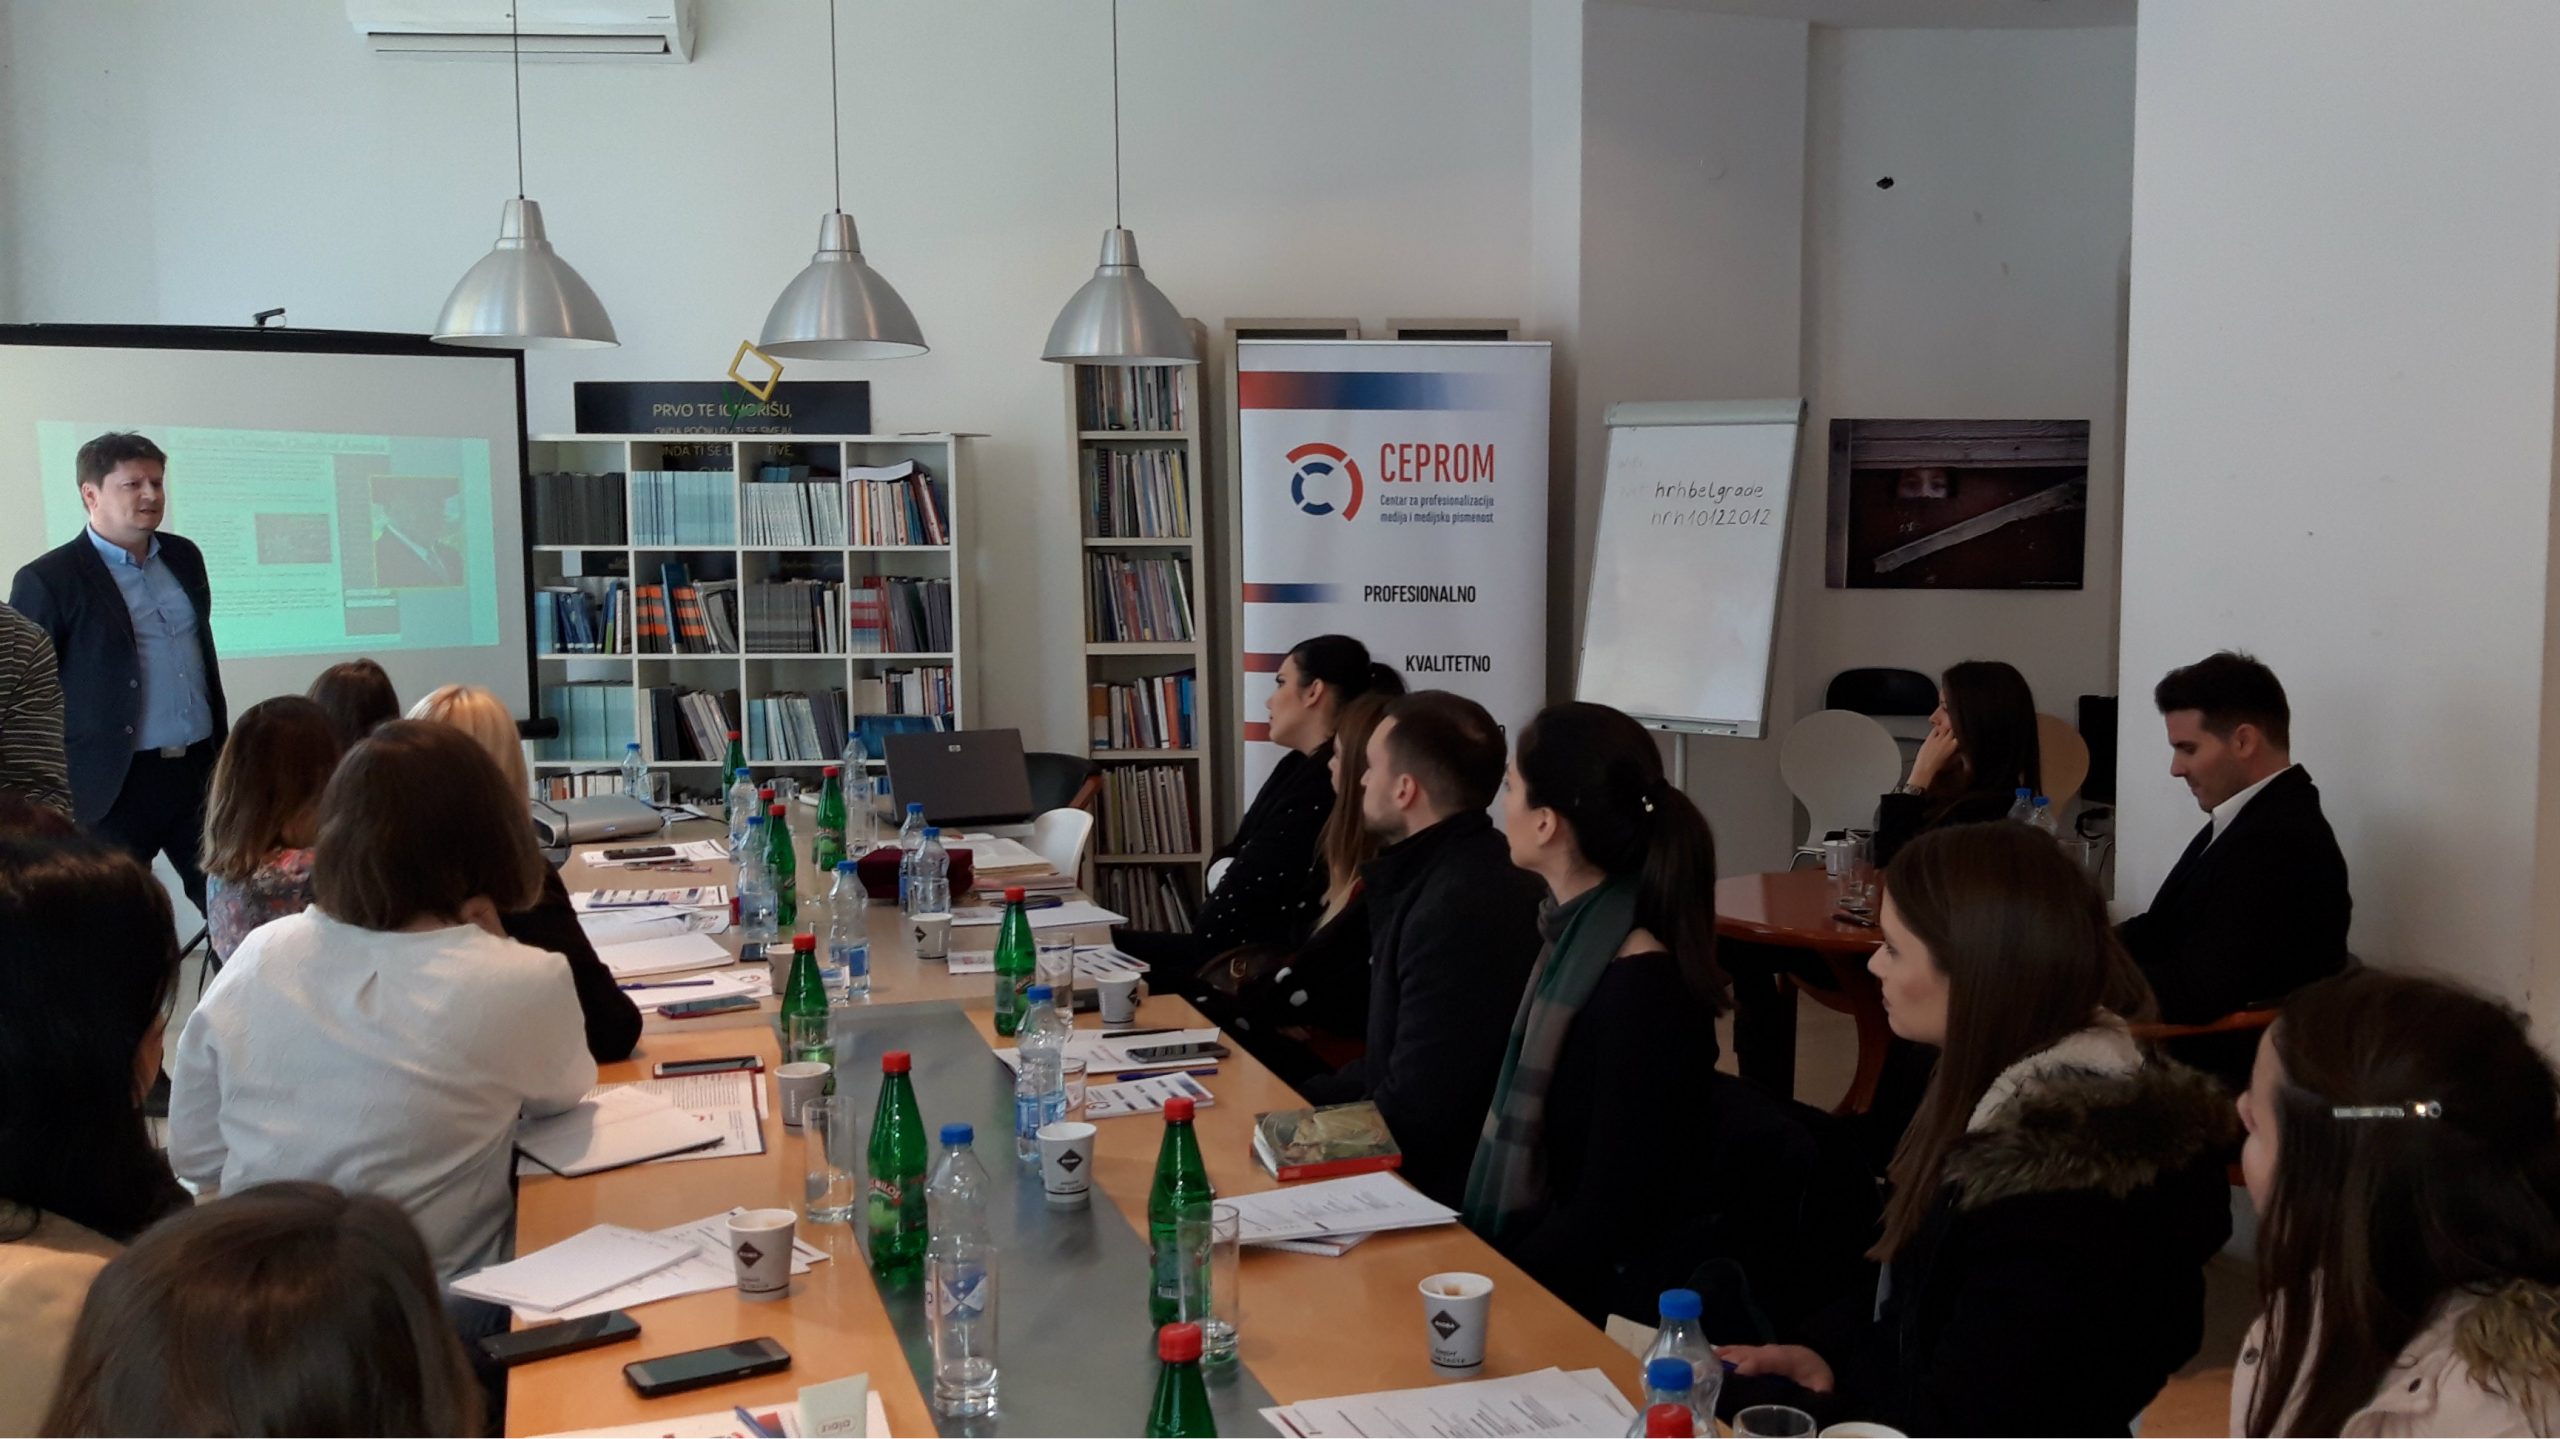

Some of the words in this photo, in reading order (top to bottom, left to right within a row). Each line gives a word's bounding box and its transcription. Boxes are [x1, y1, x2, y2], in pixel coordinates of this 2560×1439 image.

[652, 404, 694, 417] PRVO
[696, 404, 715, 417] TE
[1379, 442, 1495, 484] CEPROM
[1364, 585, 1477, 603] PROFESIONALNO
[1405, 655, 1491, 673] KVALITETNO
